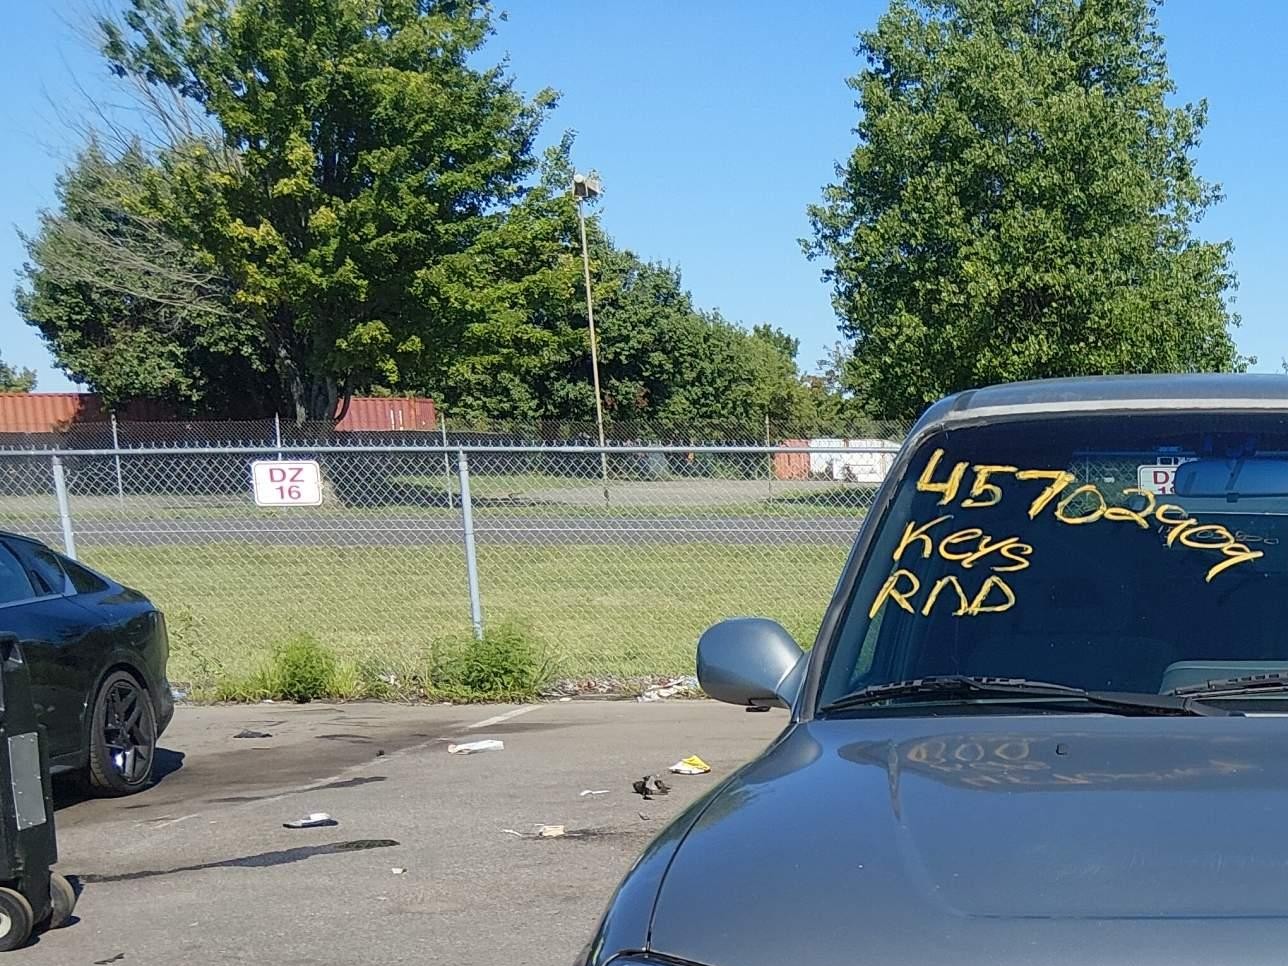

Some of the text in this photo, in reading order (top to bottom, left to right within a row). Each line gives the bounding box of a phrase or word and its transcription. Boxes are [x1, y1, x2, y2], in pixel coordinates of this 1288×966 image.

[268, 467, 305, 483] DZ
[1152, 470, 1176, 485] D
[275, 485, 302, 500] 16
[916, 447, 1264, 582] 45702909
[893, 514, 1034, 573] Keys
